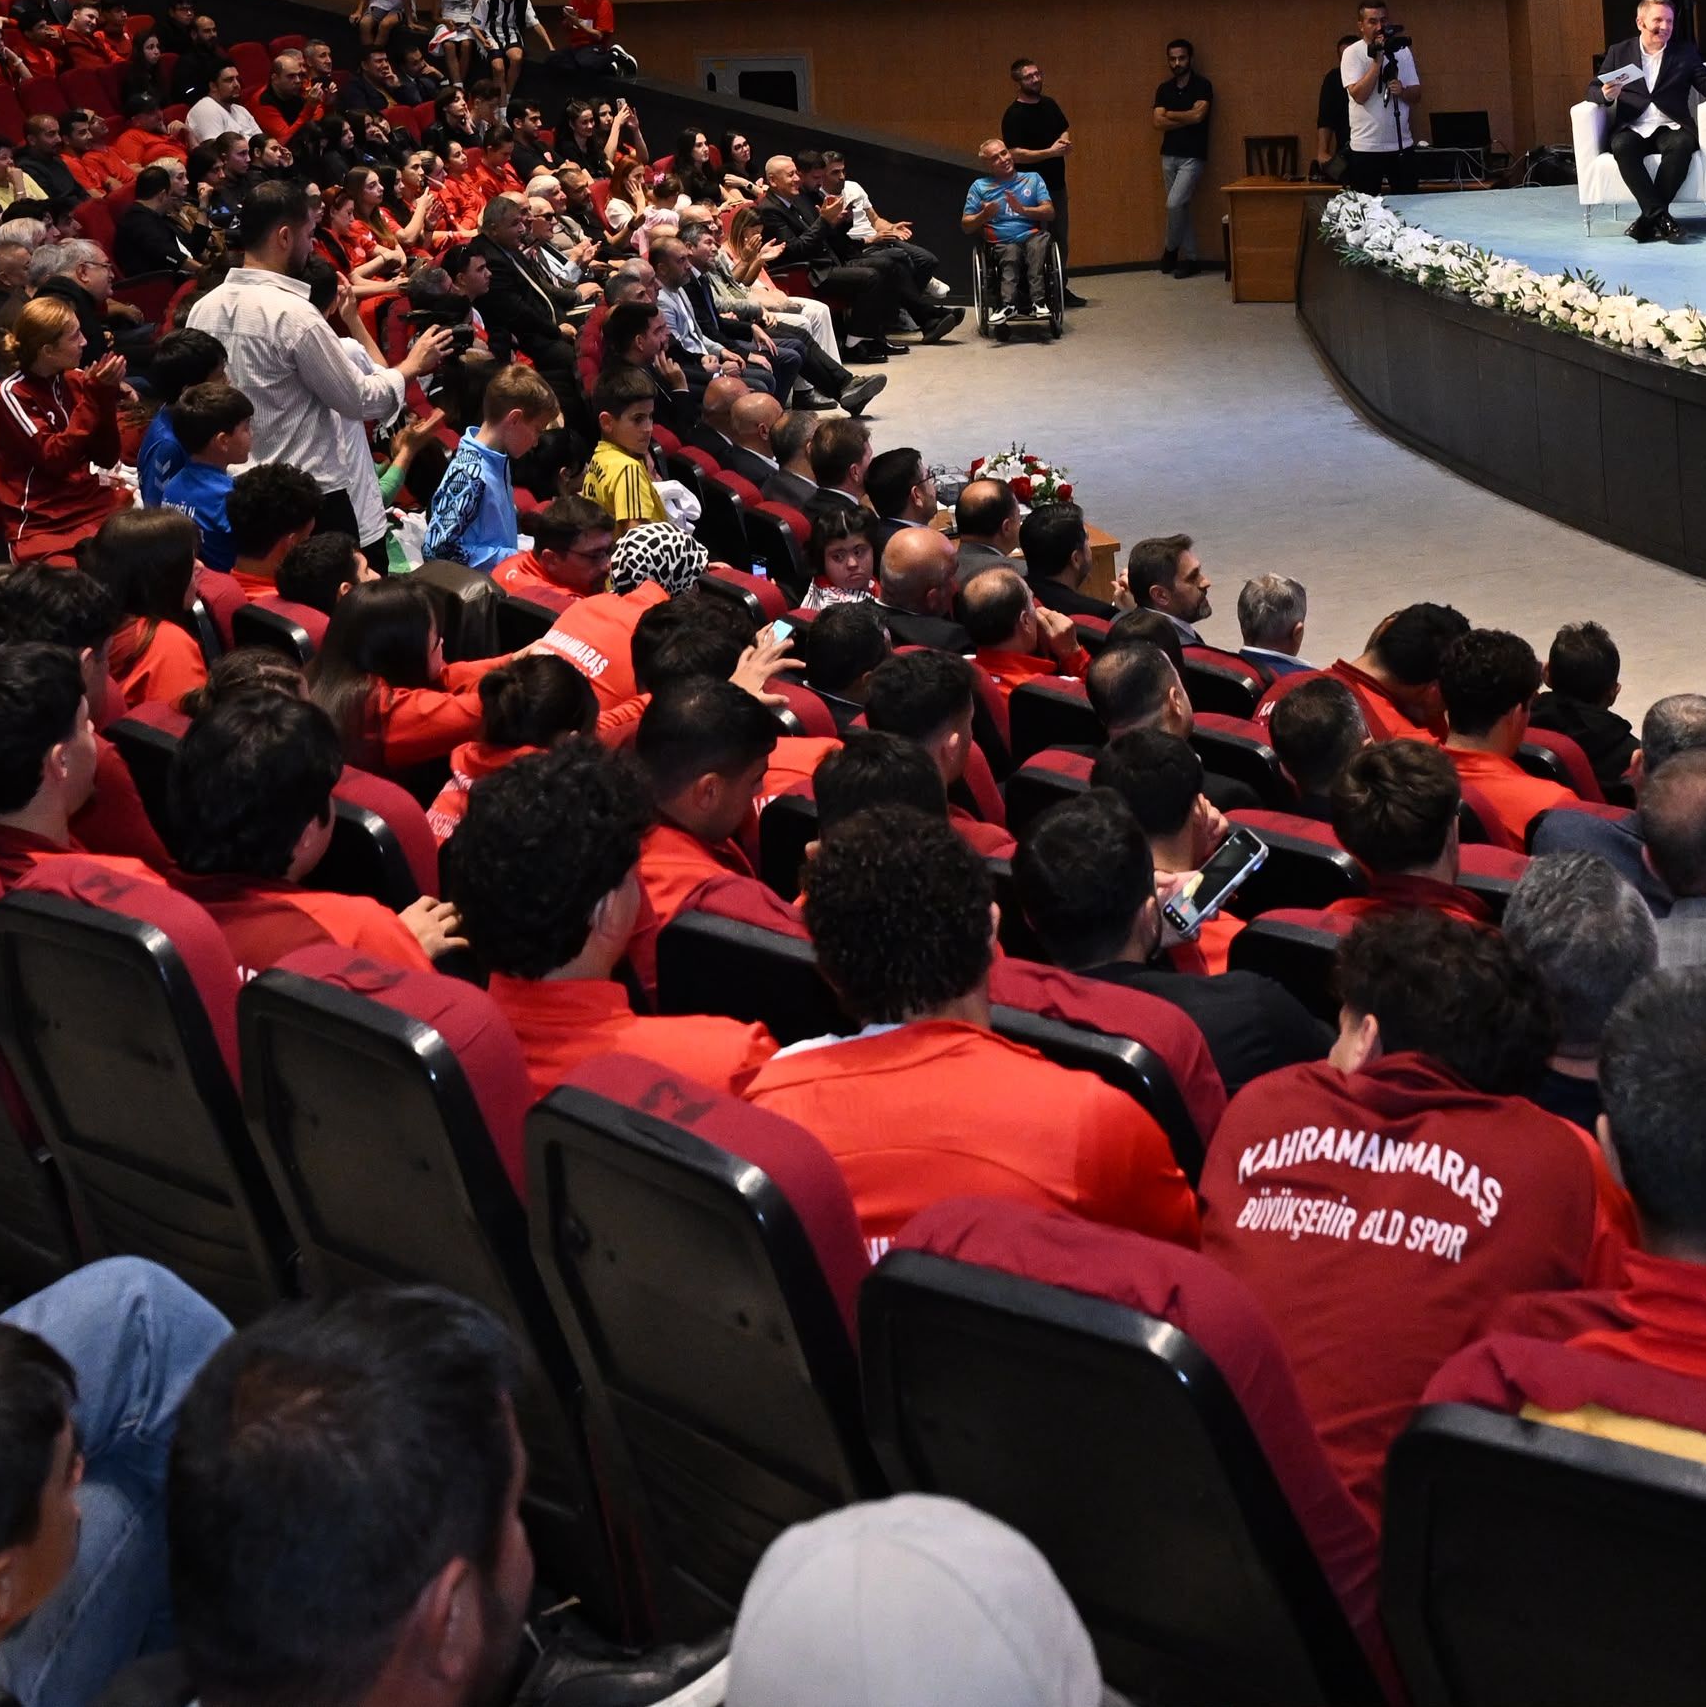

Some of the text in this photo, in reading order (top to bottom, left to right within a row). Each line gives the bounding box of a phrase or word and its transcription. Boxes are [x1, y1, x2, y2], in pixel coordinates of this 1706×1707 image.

[1237, 1124, 1503, 1227] KAHRAMANMARAŞ
[1236, 1187, 1468, 1264] BÜYÜKŞEHİR BLD SPOR
